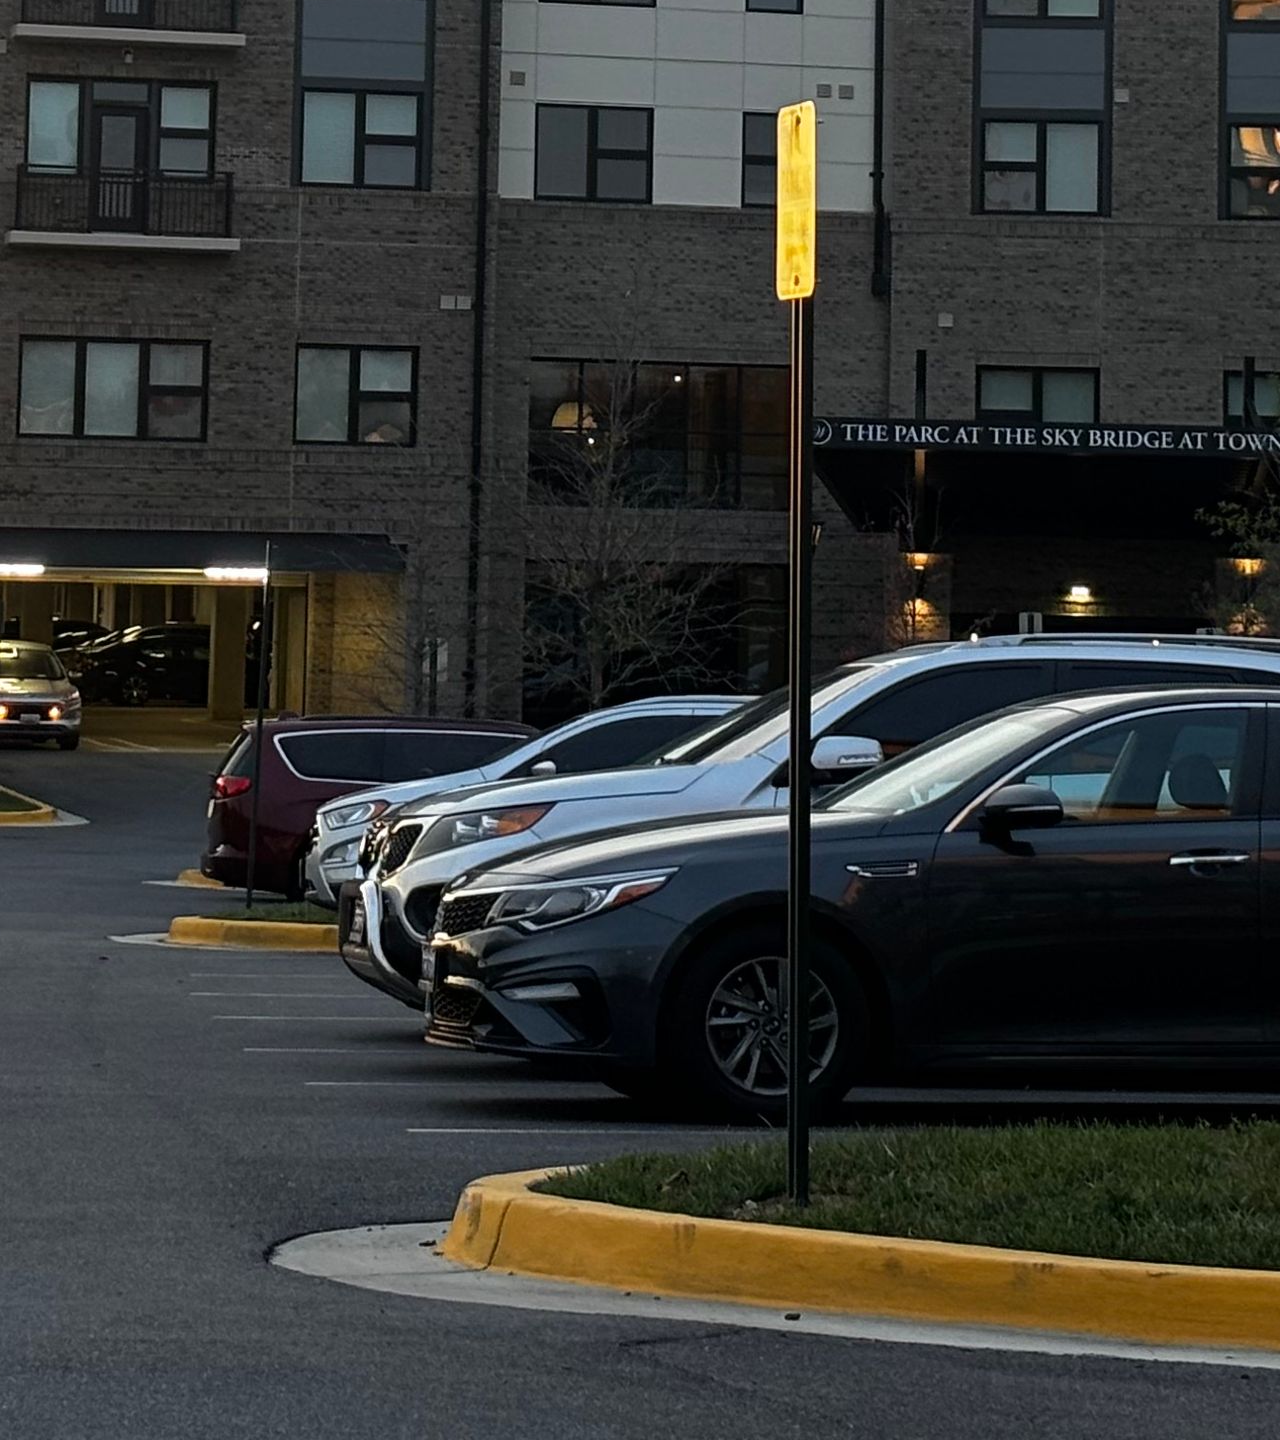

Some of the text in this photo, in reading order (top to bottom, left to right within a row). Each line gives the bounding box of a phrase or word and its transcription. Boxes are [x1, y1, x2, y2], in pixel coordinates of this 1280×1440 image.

[841, 423, 889, 442] THE
[894, 425, 951, 443] PARC
[953, 427, 984, 444] AT
[989, 427, 1037, 445] THE
[1041, 428, 1082, 447] SKY
[1088, 430, 1174, 449] BRIDGE
[1178, 432, 1209, 450] AT
